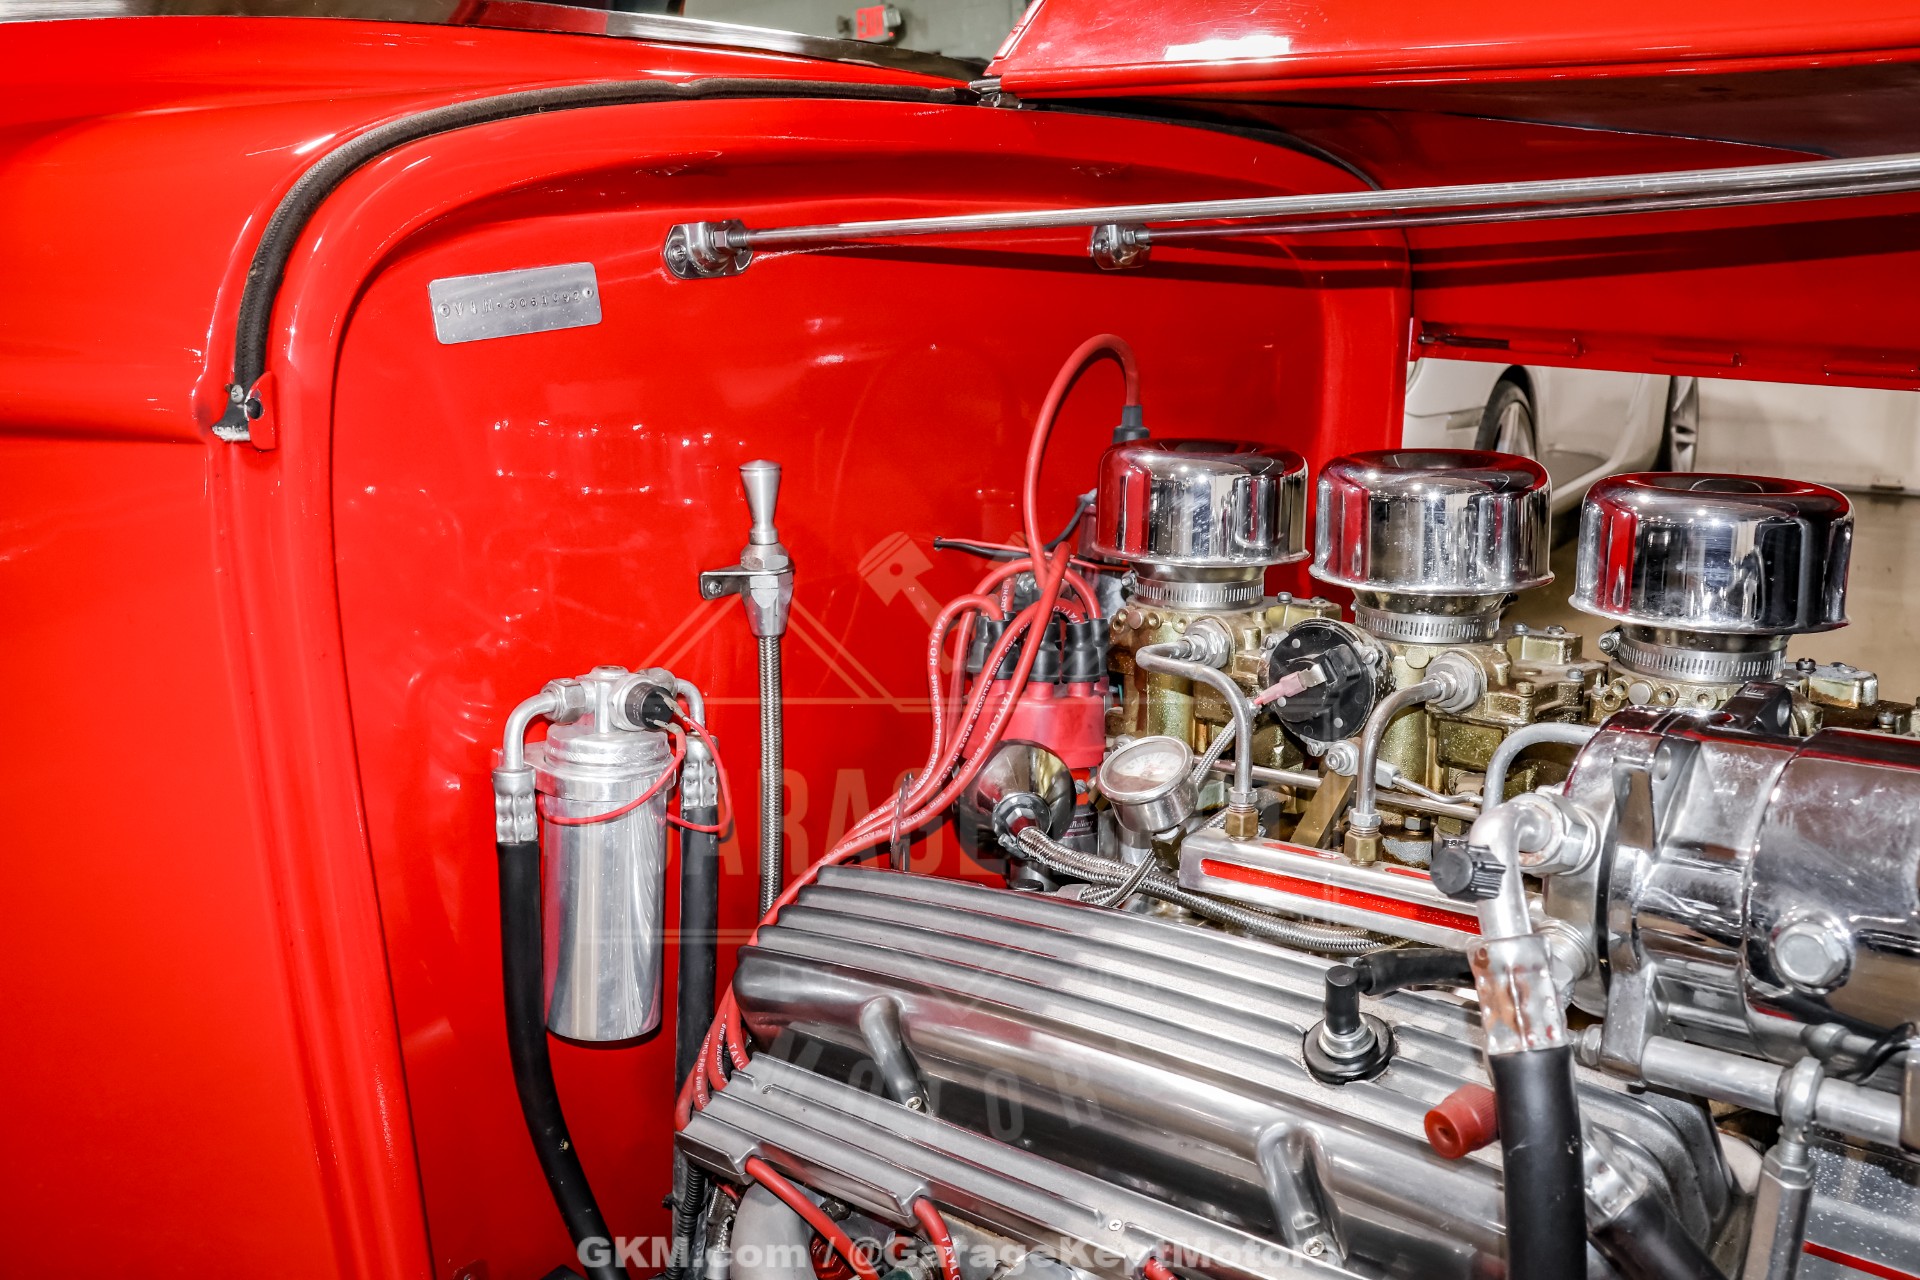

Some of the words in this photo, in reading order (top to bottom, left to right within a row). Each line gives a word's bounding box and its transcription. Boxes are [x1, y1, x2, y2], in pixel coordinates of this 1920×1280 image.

[1052, 606, 1080, 623] TAYLO
[929, 615, 946, 666] TAYLOR
[930, 674, 940, 701] SPIRO
[971, 679, 993, 720] SILICONE
[934, 706, 942, 724] PRO
[984, 691, 1013, 741] TAYLOR
[914, 752, 938, 790] SILICONE
[729, 1043, 746, 1071] TAYL
[941, 1234, 961, 1280] TAYLO
